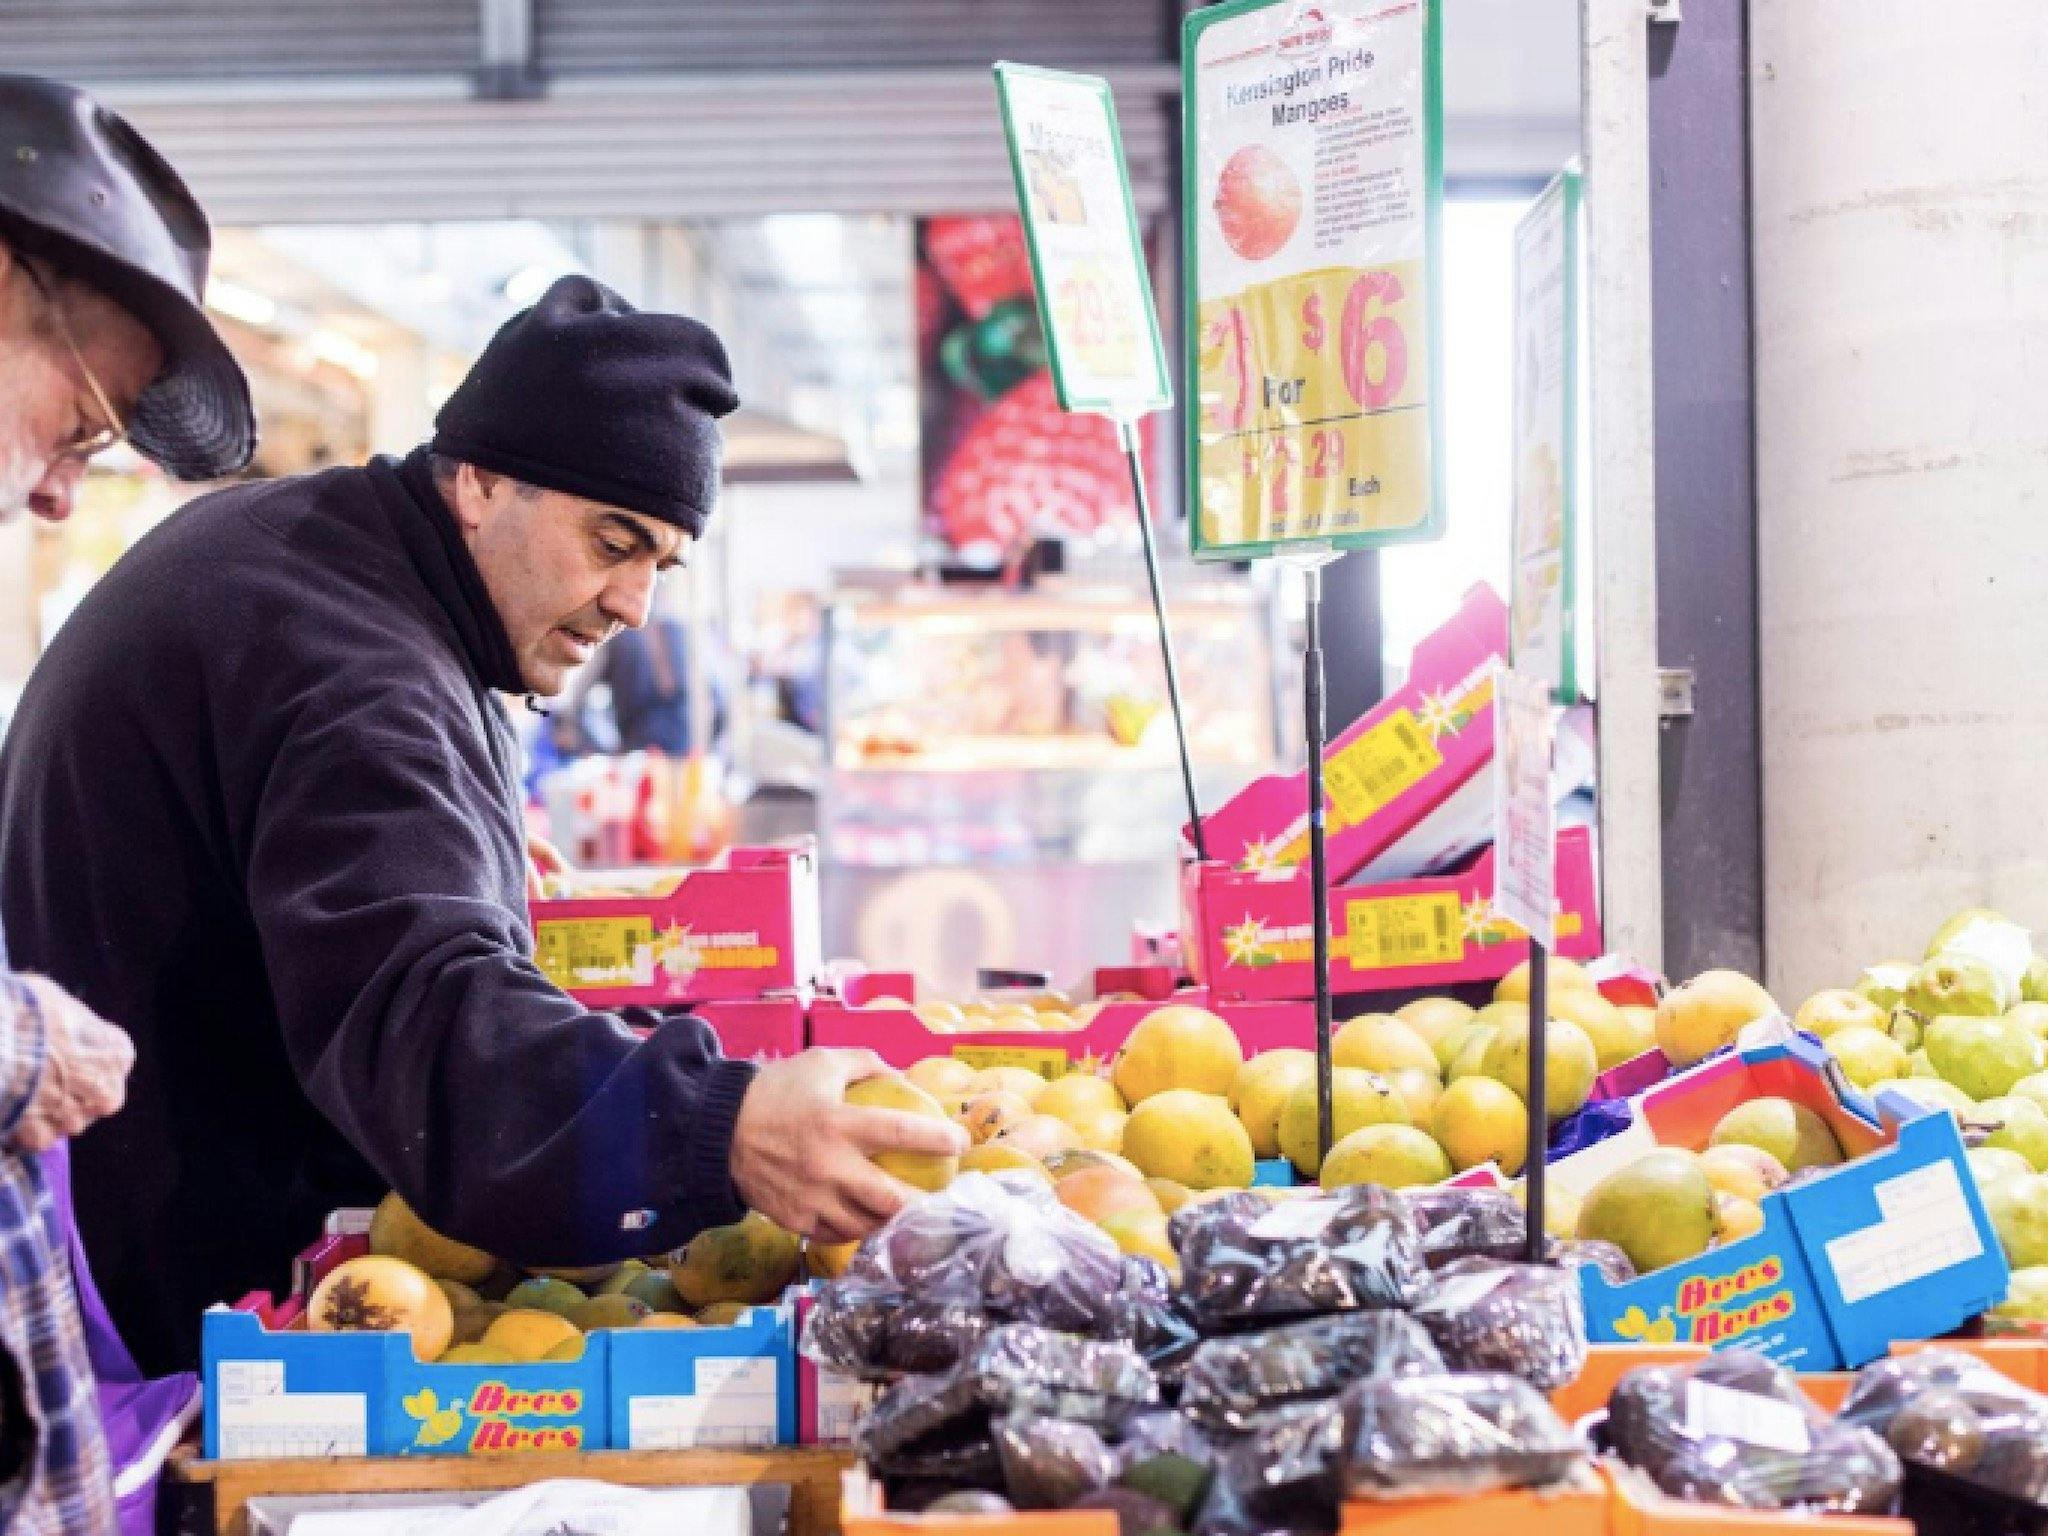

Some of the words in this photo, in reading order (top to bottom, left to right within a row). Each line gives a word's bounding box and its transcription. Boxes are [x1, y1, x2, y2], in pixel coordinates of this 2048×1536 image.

[1225, 67, 1321, 107] Kensington
[1328, 48, 1375, 79] Pride
[1272, 92, 1351, 126] Mangoes
